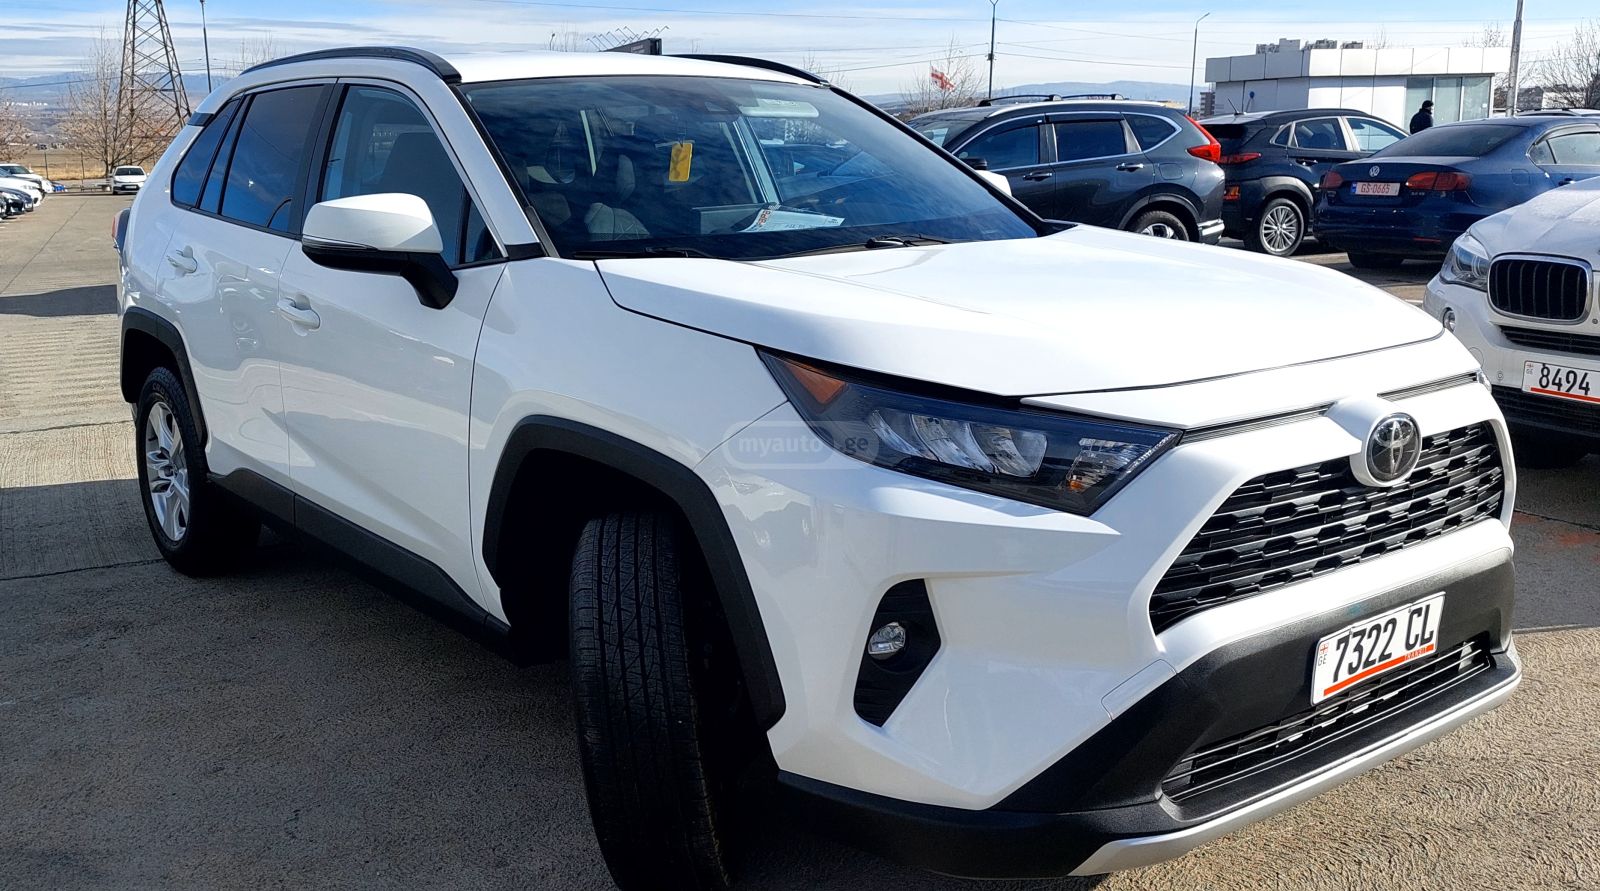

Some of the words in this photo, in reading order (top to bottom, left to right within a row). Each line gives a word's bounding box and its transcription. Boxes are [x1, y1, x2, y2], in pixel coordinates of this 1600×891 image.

[1539, 365, 1590, 395] 8494
[1333, 617, 1397, 683] 7322
[1405, 604, 1434, 650] CL
[1318, 654, 1327, 667] GE
